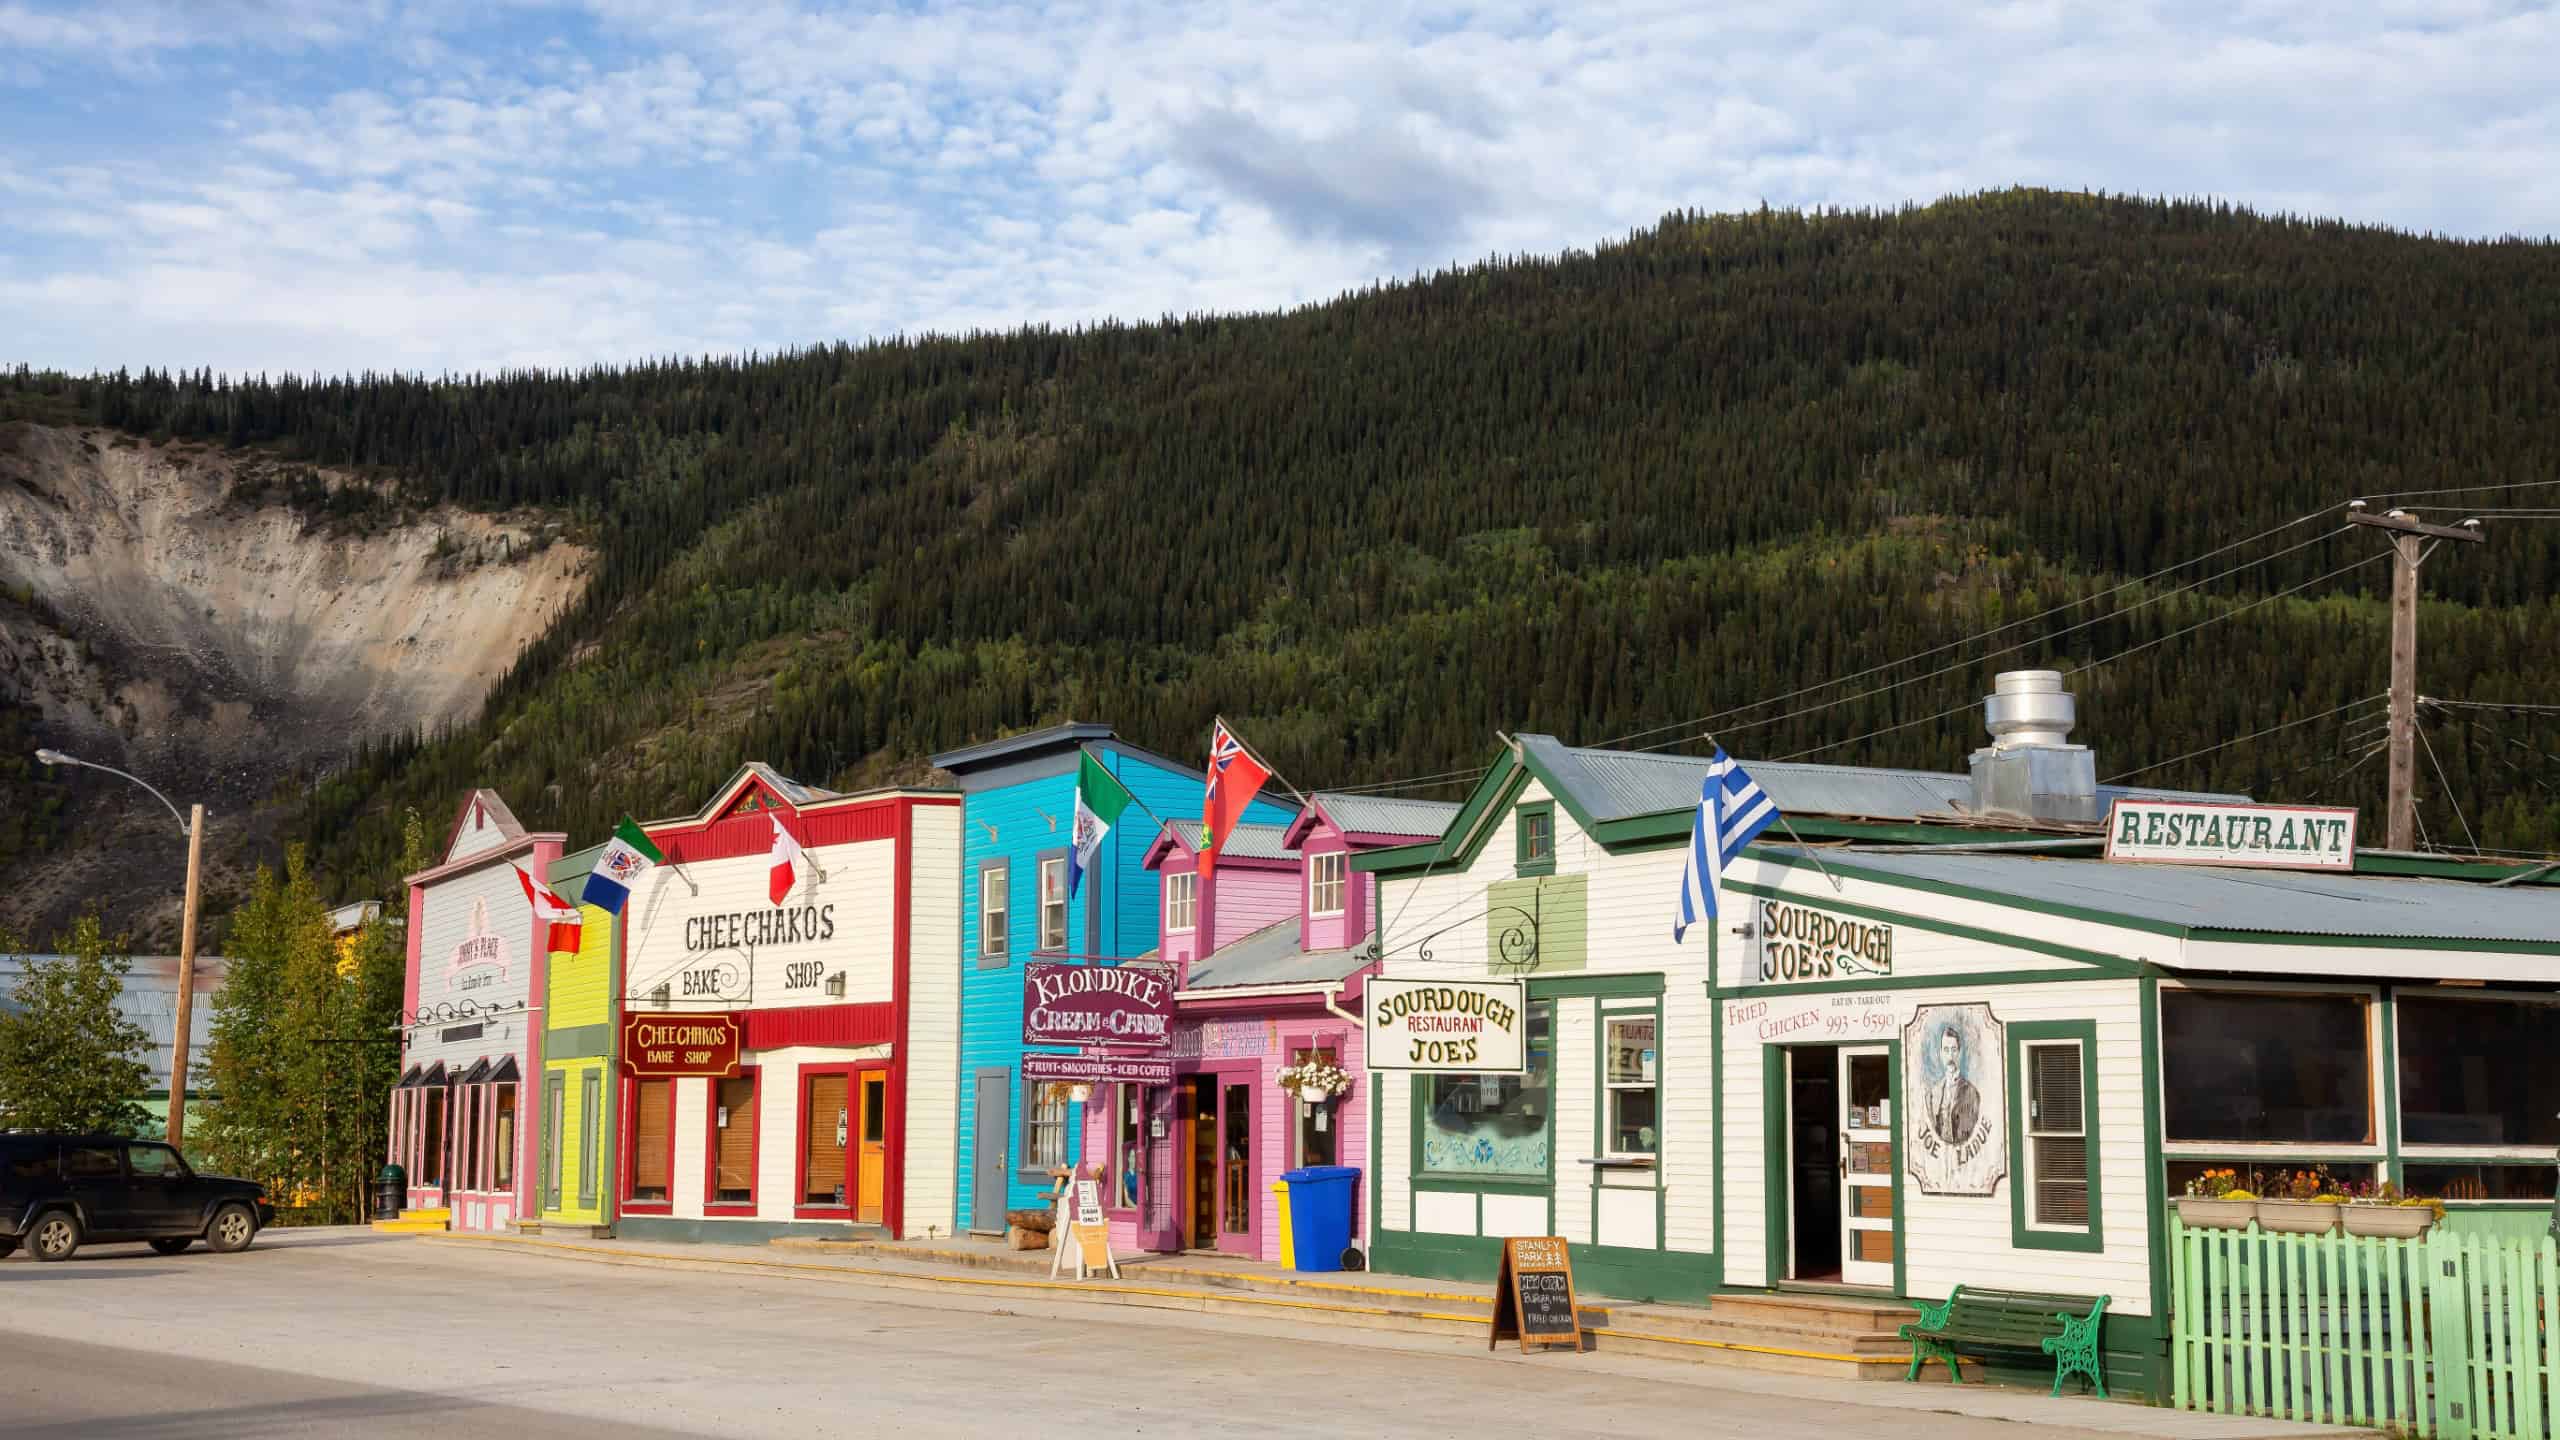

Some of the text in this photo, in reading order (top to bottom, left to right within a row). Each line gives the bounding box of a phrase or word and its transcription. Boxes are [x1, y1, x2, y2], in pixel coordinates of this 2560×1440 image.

[2117, 811, 2347, 852] RESTAURANT
[686, 904, 834, 951] CHEECHAKOS
[1763, 901, 1890, 965] SOURDOUGH
[1763, 943, 1834, 980] JOE'S
[683, 961, 824, 995] BAKE SHOP
[1032, 968, 1162, 1009] KLONDYKE
[1030, 1007, 1100, 1032] CREAM
[1109, 1009, 1169, 1035] CANDY
[1378, 988, 1516, 1033] SOURDOUGH
[1408, 1016, 1484, 1033] RESTAURANT
[1728, 1001, 1768, 1026] FRIED
[1759, 1008, 1820, 1041] CHICKEN
[1826, 1015, 1849, 1034] 993
[638, 1024, 727, 1048] CHEECHAKOS
[1409, 1036, 1477, 1063] JOE'S
[647, 1050, 712, 1064] BAKE SHOP
[1027, 1061, 1057, 1073] FRUIT
[1117, 1064, 1138, 1076] ICED
[1139, 1065, 1171, 1076] COFFEE
[1918, 1115, 1993, 1166] JOE LADUE
[1516, 1240, 1560, 1251] STANLEY
[1518, 1251, 1542, 1261] PARK
